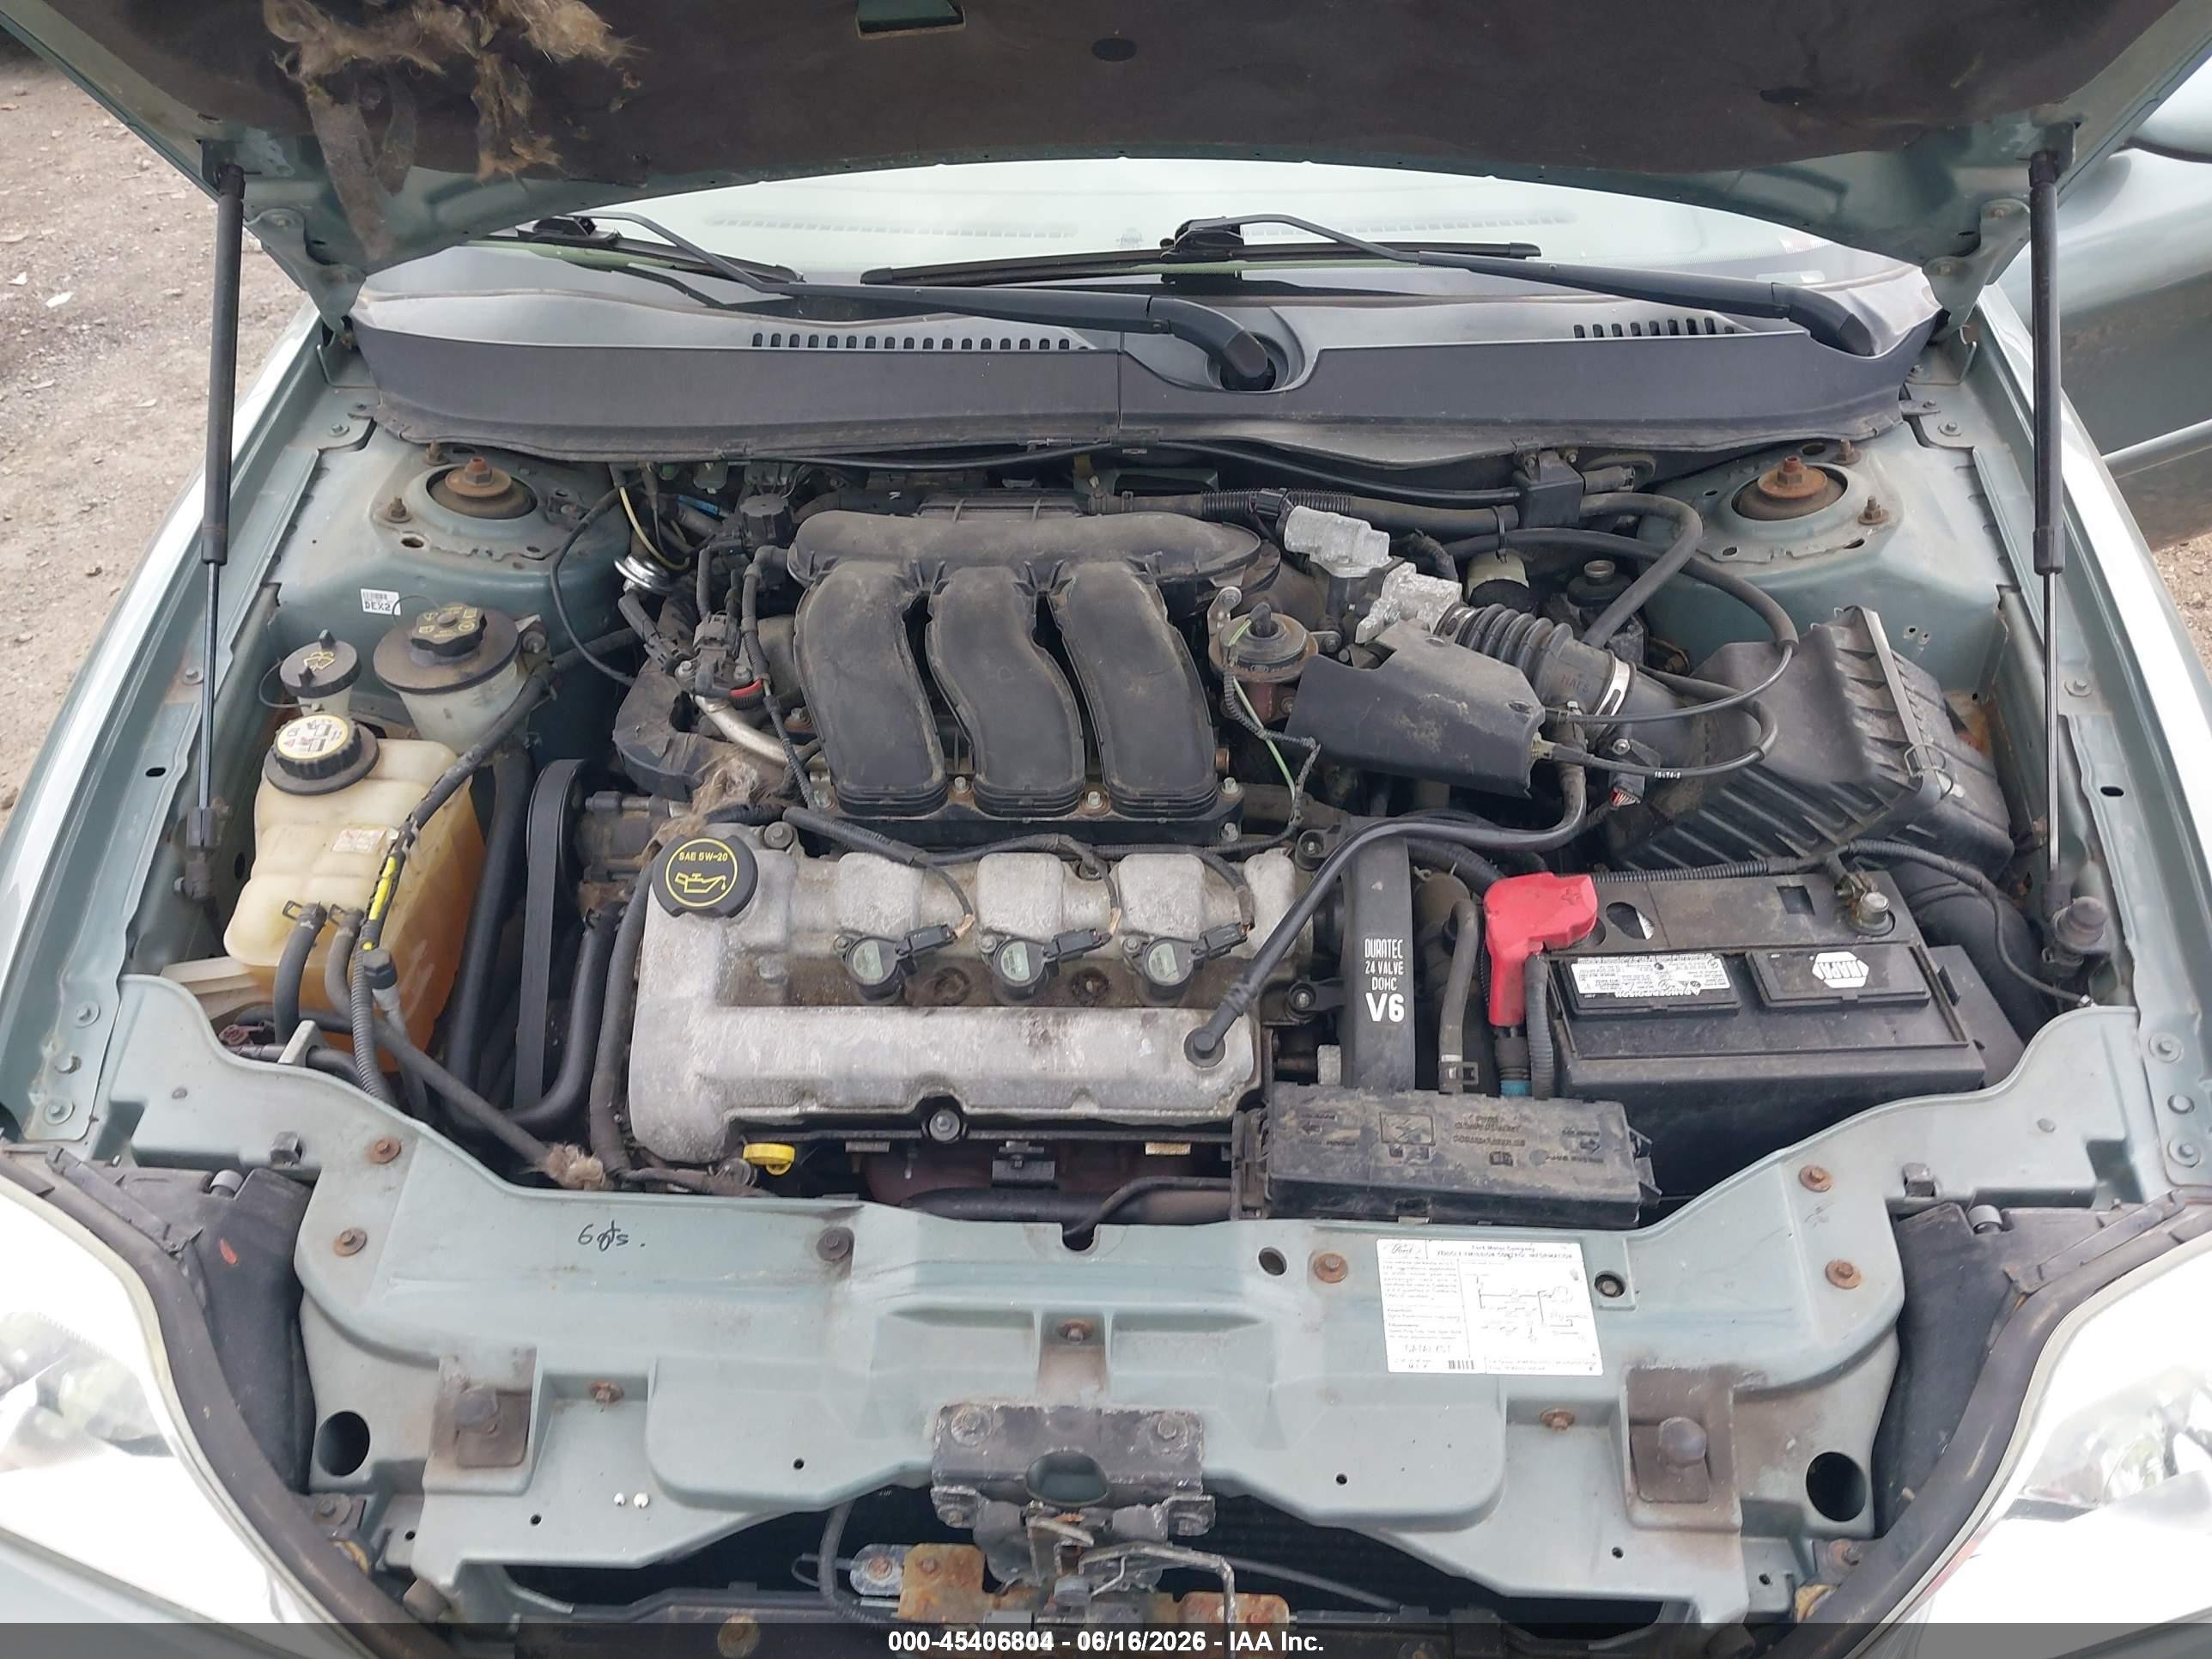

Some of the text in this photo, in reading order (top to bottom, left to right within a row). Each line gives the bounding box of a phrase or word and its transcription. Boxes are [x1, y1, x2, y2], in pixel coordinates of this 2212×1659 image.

[1364, 938, 1404, 959] DURATEC
[1365, 961, 1404, 975] 24 VALVE
[1371, 976, 1397, 991] DOHC
[1365, 992, 1405, 1022] V6
